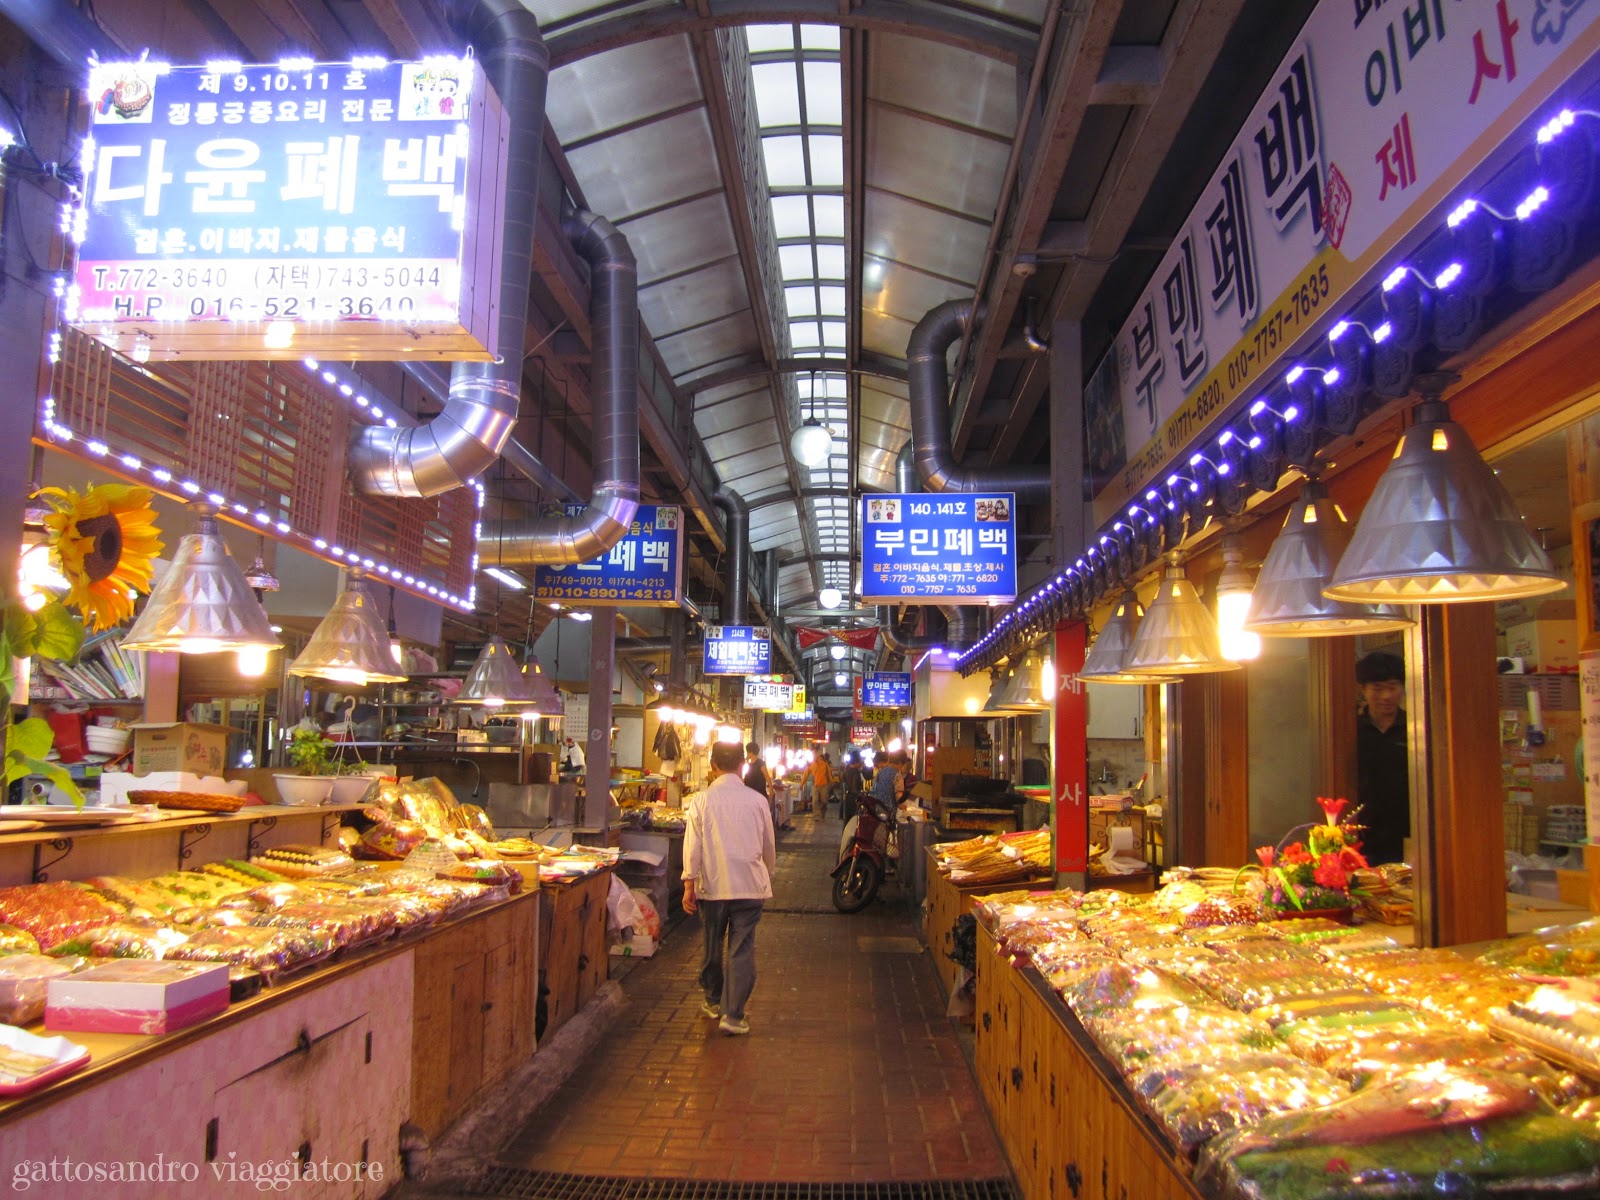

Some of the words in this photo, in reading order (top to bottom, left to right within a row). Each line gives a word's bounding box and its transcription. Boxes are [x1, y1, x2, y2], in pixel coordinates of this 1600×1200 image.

[198, 73, 221, 94] 제
[234, 73, 329, 93] 9.10.11
[342, 71, 367, 91] 호
[341, 98, 394, 122] 전문
[95, 133, 458, 216] 다윤폐백
[1132, 54, 1324, 425] 부민폐백
[94, 268, 227, 289] T.772-3640
[114, 297, 163, 317] H.P
[1228, 264, 1330, 390] 010-7757-7635
[567, 505, 588, 516] 제7
[625, 521, 653, 536] 음식
[874, 529, 1008, 556] 부민폐백
